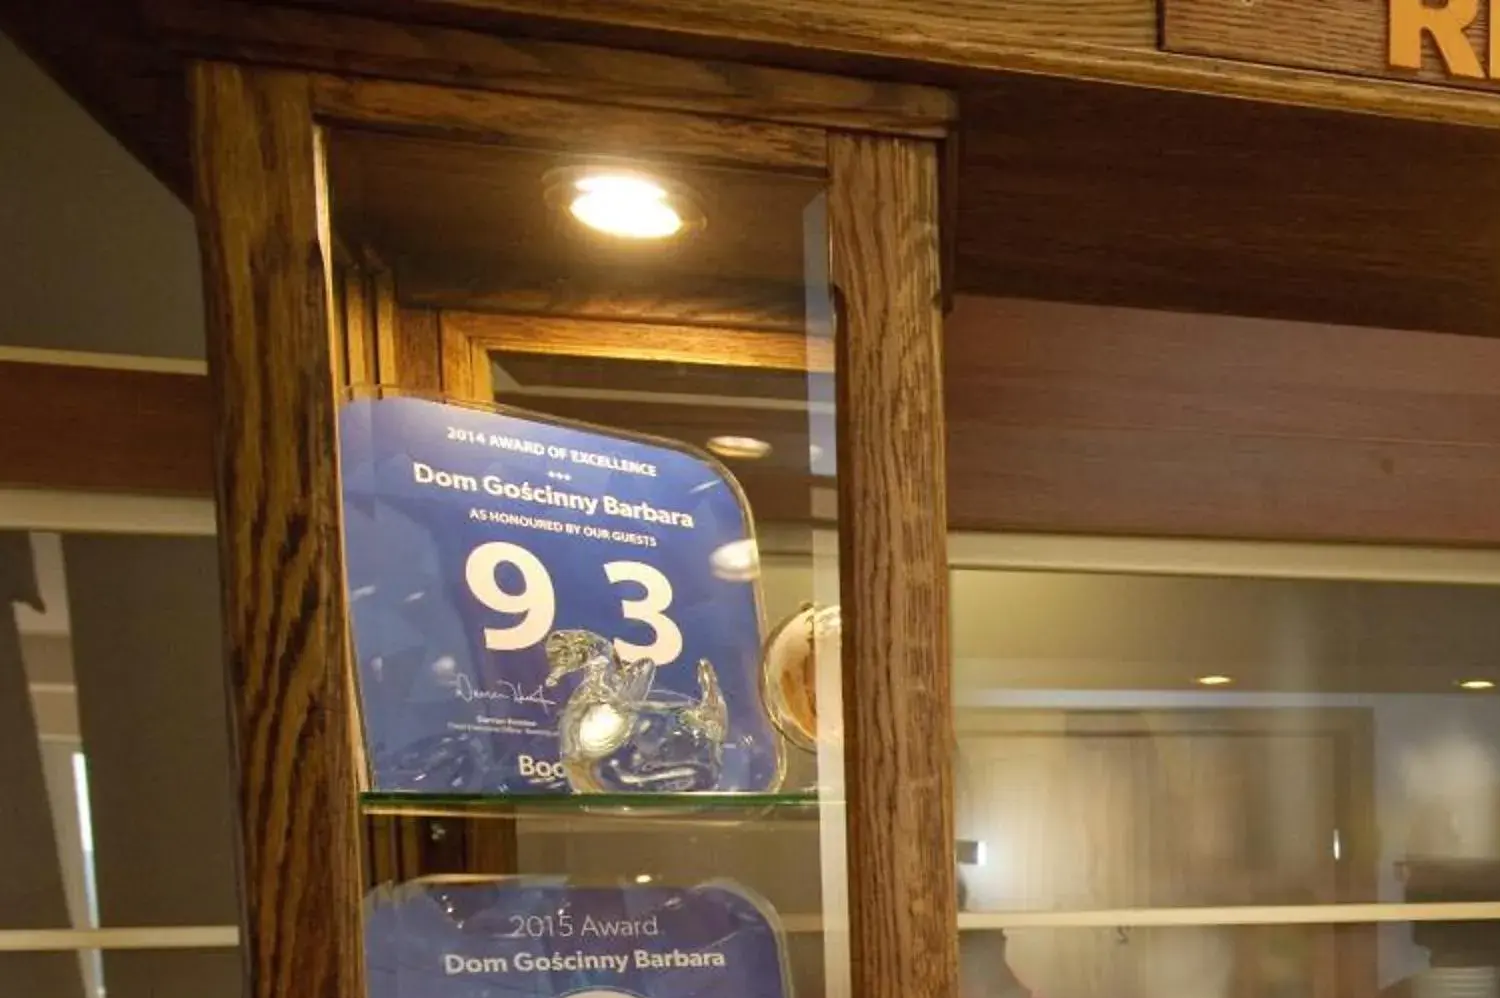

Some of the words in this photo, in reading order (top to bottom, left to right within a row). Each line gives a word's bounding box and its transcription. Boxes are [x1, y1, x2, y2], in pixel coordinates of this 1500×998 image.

[446, 426, 485, 445] 2014
[488, 434, 545, 456] AWARD
[547, 445, 568, 460] OF
[570, 450, 657, 478] EXCELLENCE
[413, 461, 478, 492] Dom
[483, 474, 598, 516] Gościnny
[603, 495, 695, 529] Barbara
[469, 507, 488, 522] AS
[489, 510, 564, 533] HONOURED
[565, 522, 582, 537] BY
[583, 525, 611, 541] OUR
[611, 530, 657, 547] GUESTS
[518, 753, 564, 779] Boo
[508, 914, 573, 938] 2015
[580, 914, 659, 938] Award
[444, 953, 508, 975] Dom
[513, 950, 629, 974] Gościnny
[634, 947, 726, 969] Barbara
